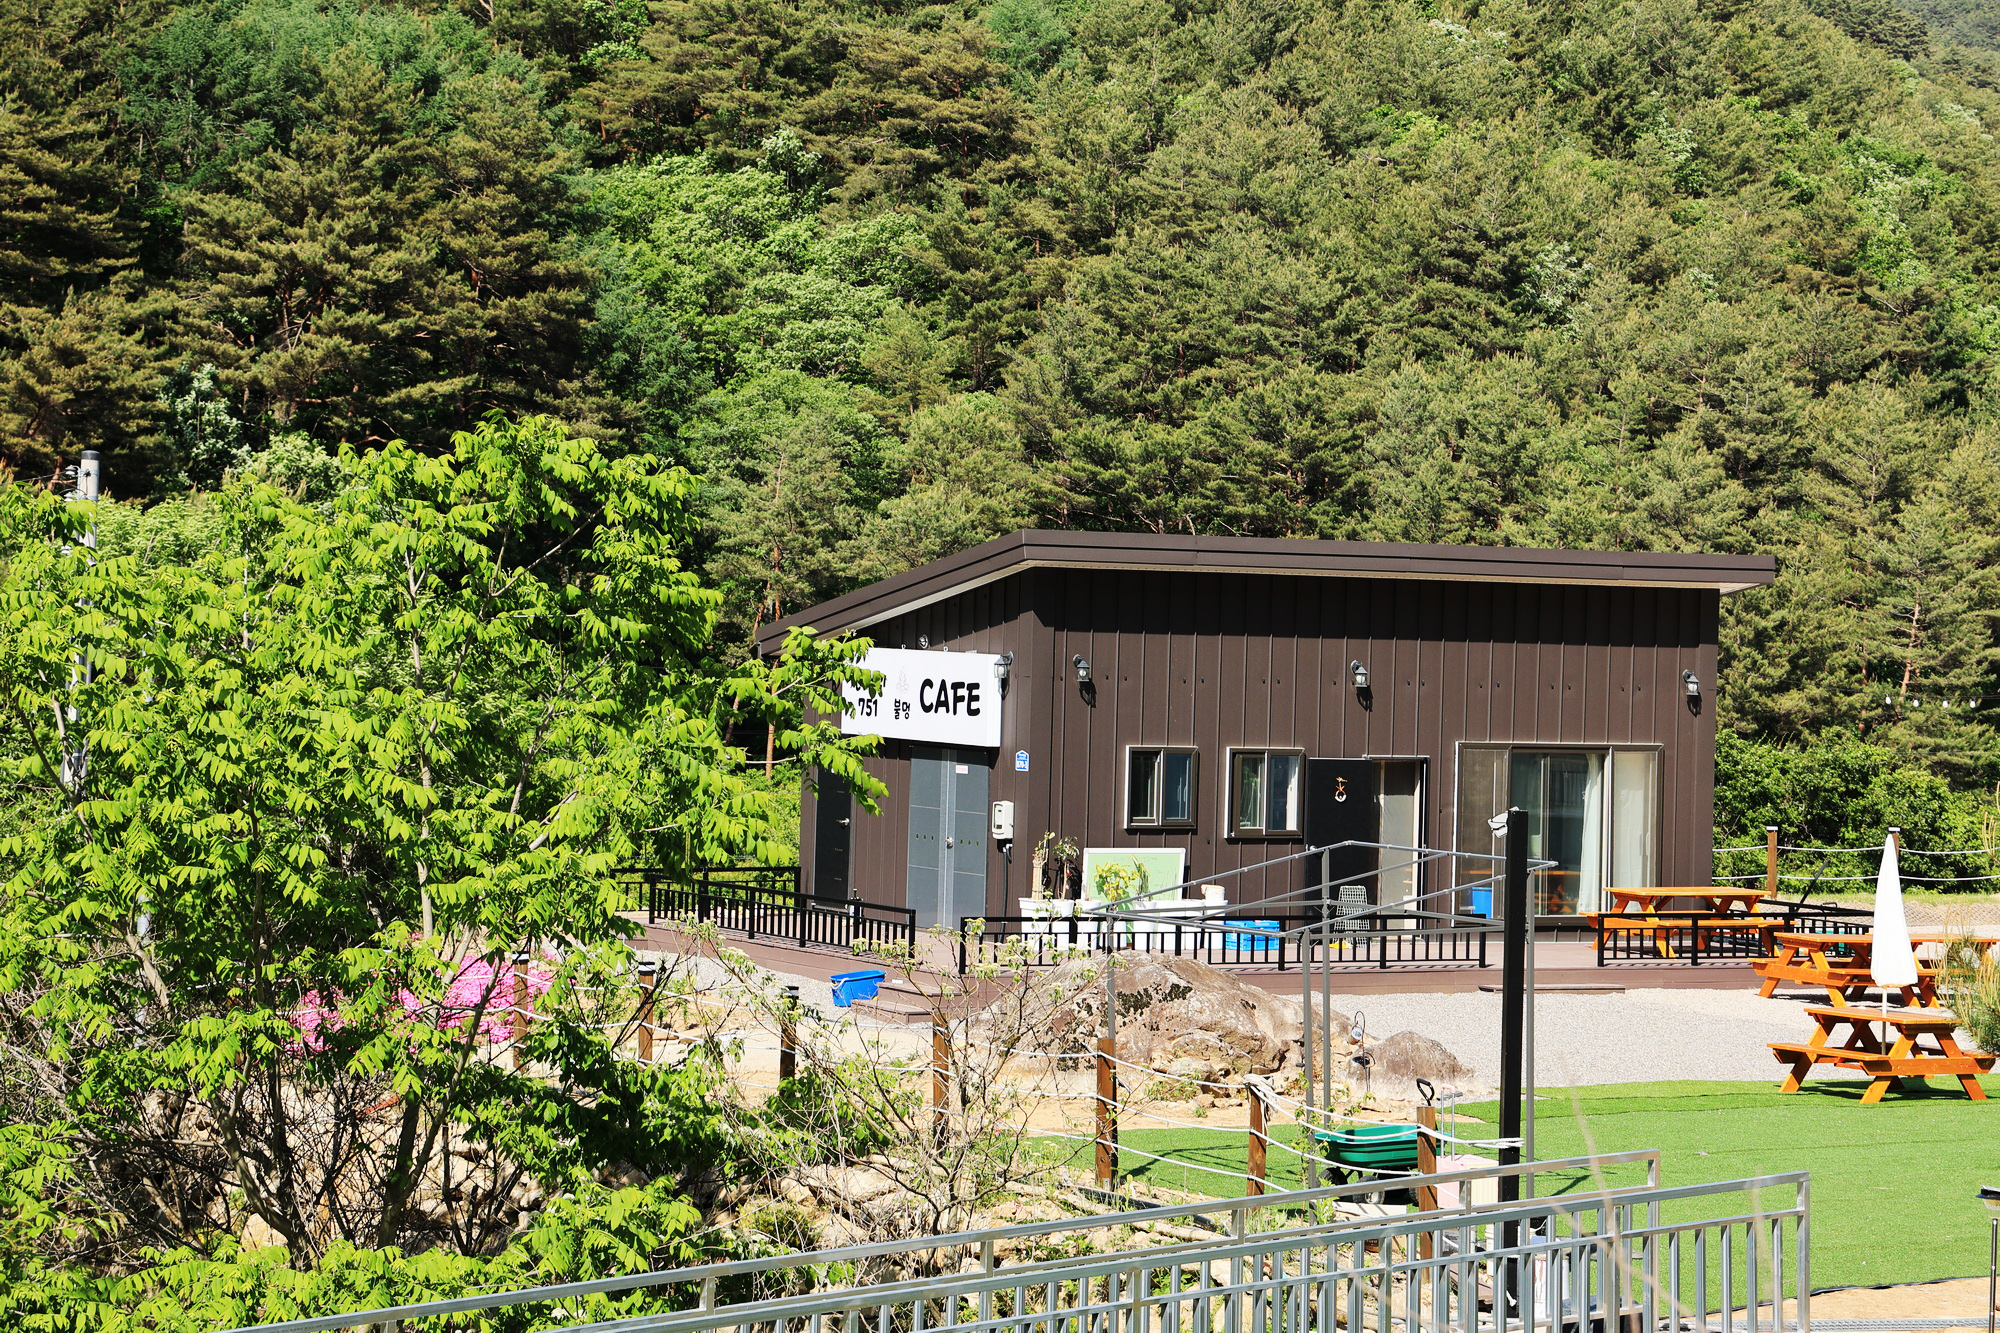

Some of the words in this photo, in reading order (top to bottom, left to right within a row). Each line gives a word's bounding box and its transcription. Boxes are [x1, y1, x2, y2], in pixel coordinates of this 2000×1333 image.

[858, 698, 878, 717] 751
[919, 678, 981, 717] CAFE
[894, 698, 911, 720] 불멍
